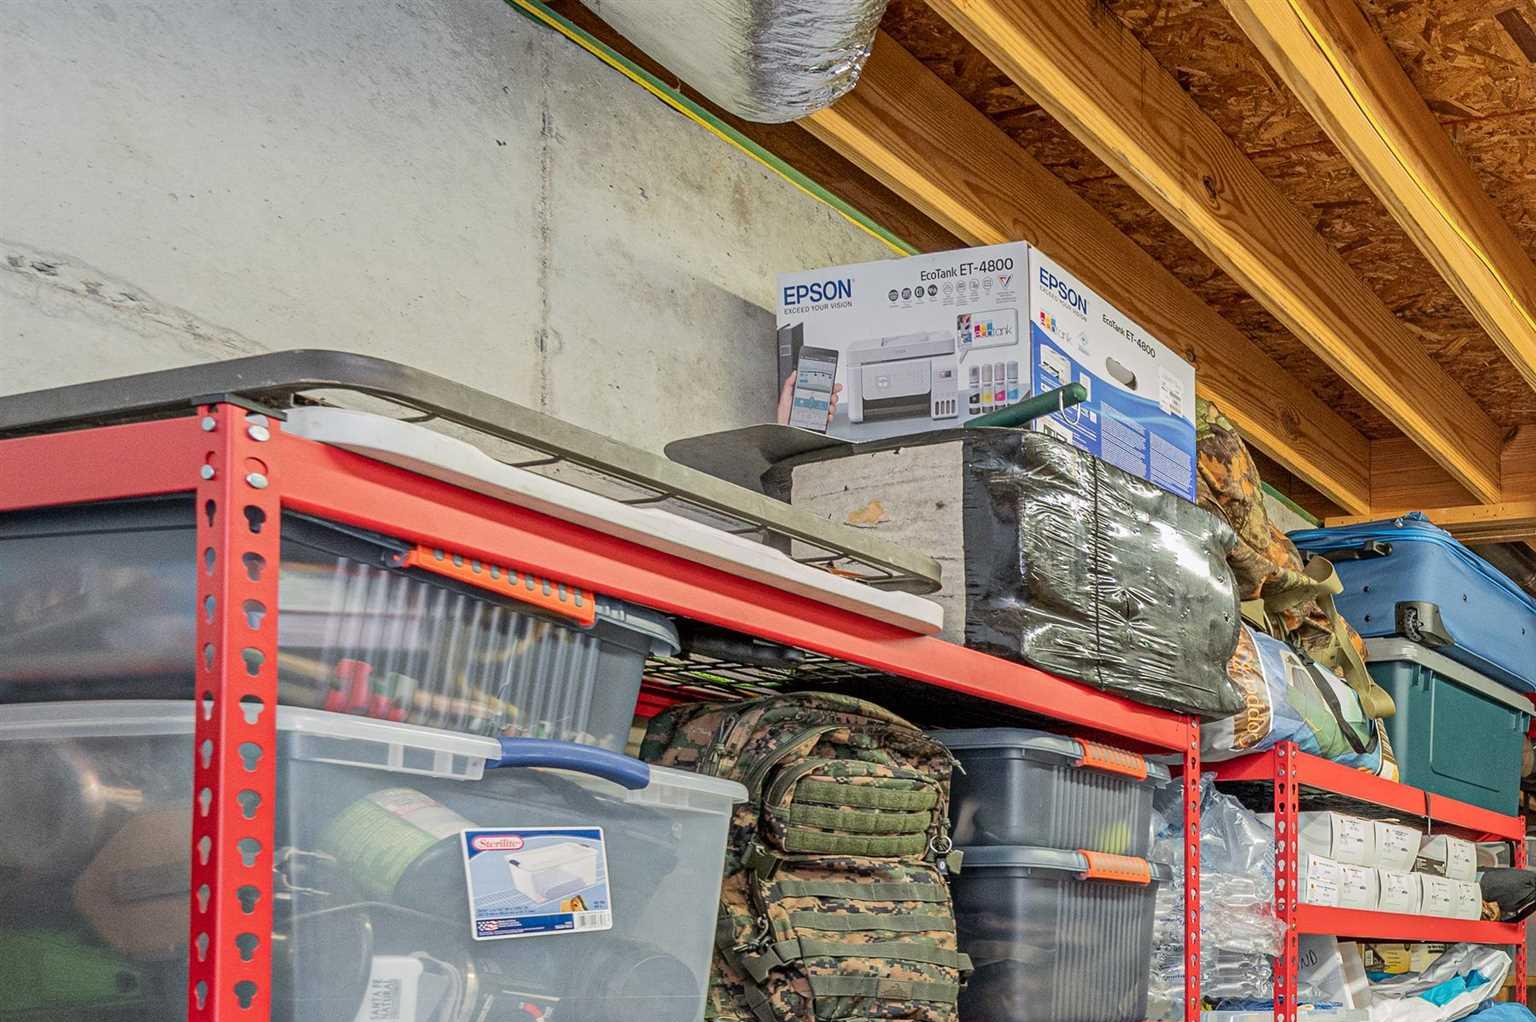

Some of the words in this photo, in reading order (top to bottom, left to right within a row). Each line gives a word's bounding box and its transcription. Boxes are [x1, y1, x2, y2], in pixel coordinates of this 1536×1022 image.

[920, 268, 958, 281] EcoTank
[960, 257, 1014, 276] ET-4800
[783, 278, 852, 306] EPSON
[1040, 266, 1087, 315] EPSON
[784, 306, 810, 315] EXCEED
[811, 303, 829, 312] YOUR
[830, 301, 853, 311] VISION
[1102, 314, 1125, 337] EcoTank
[1125, 329, 1156, 358] ET-4800
